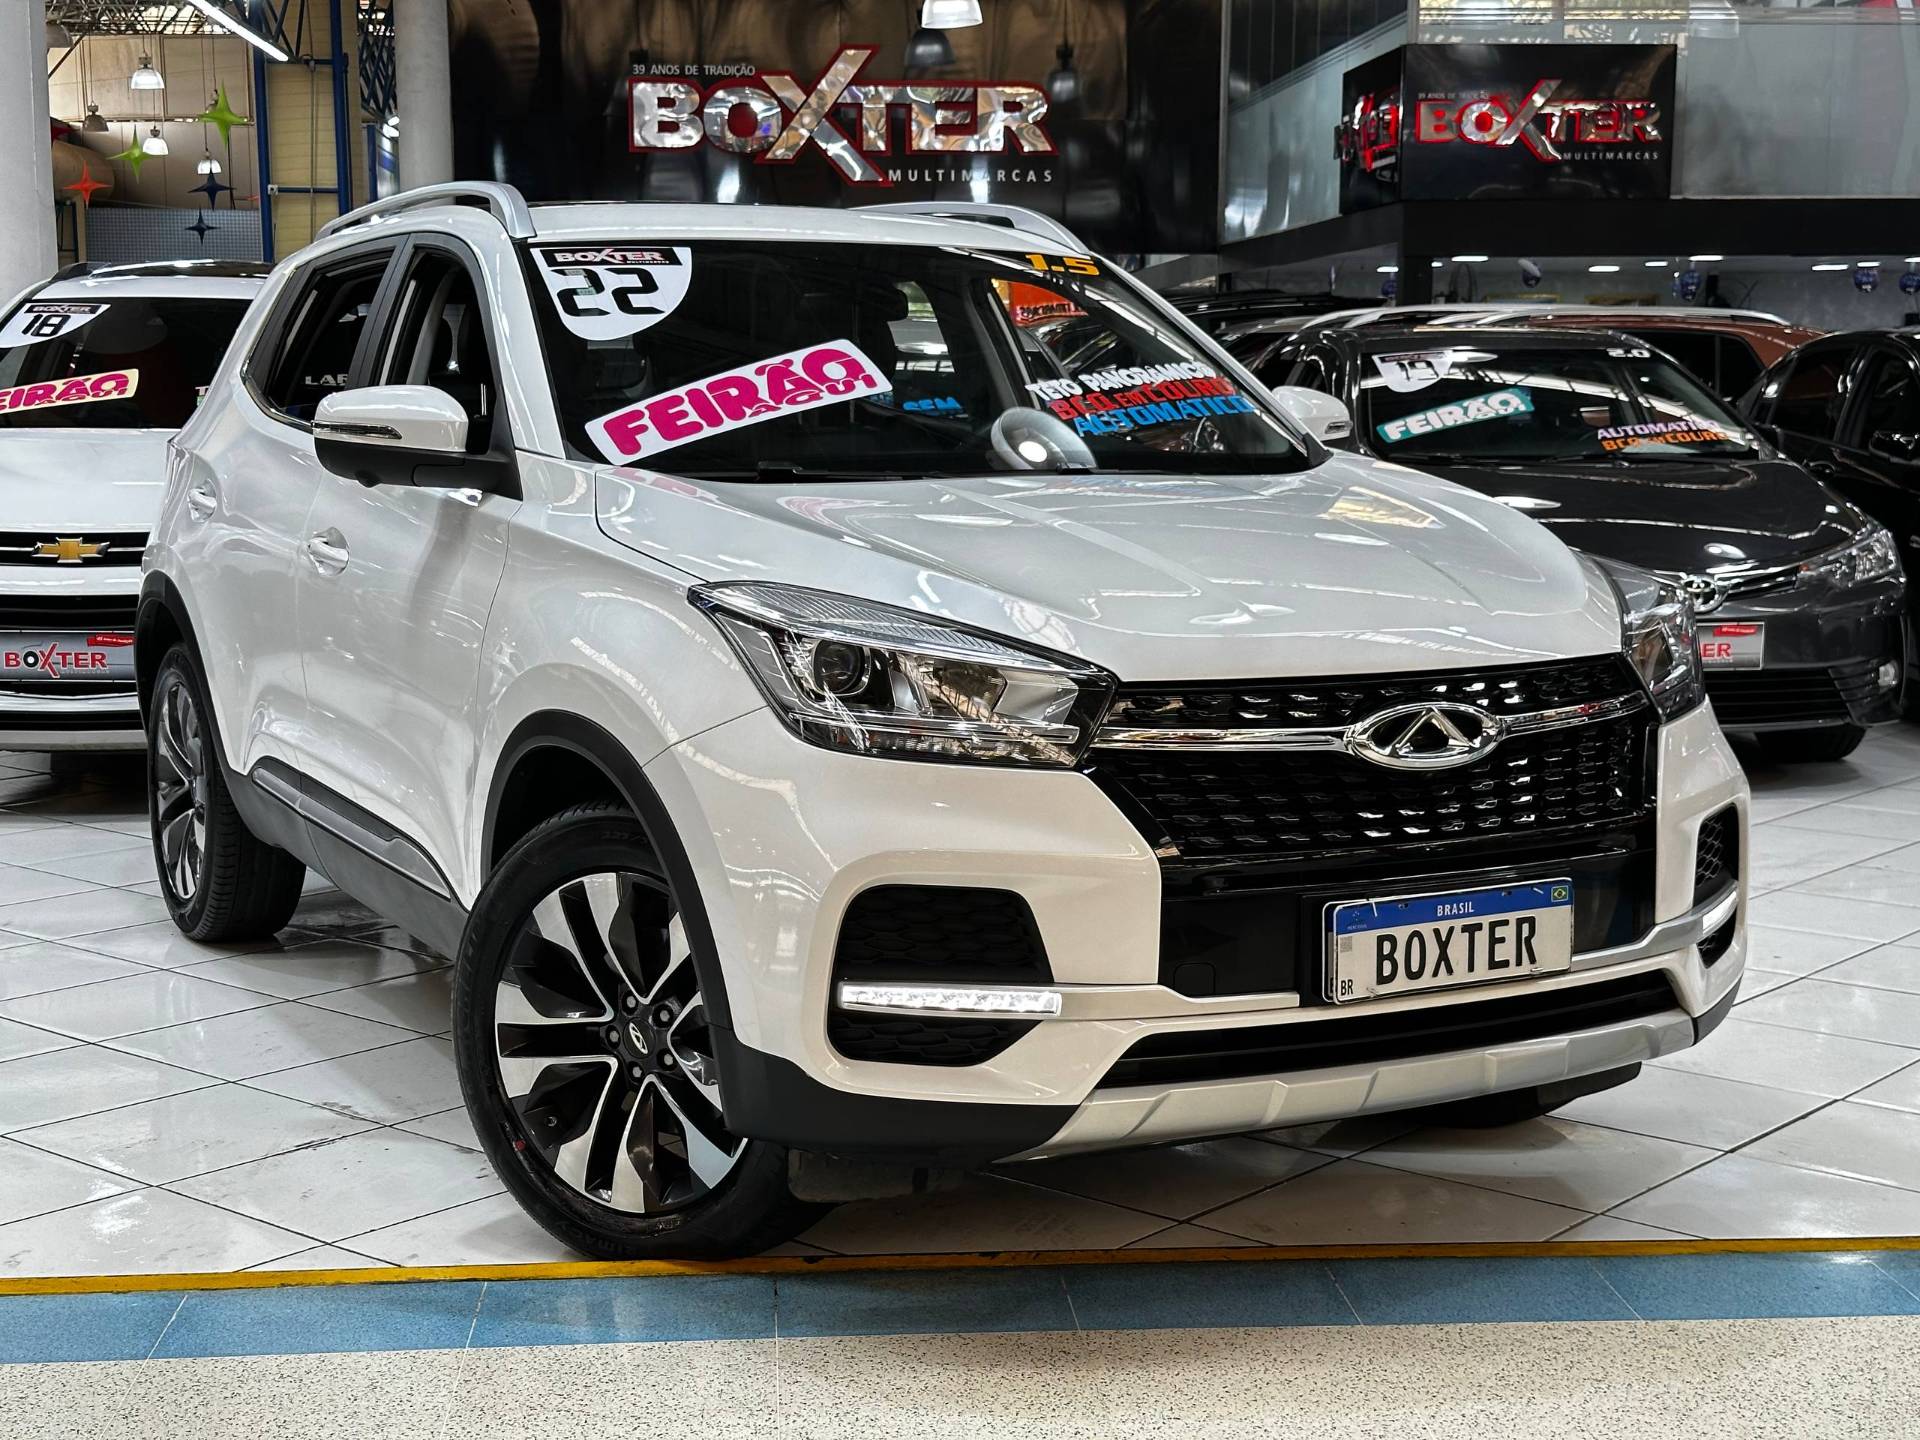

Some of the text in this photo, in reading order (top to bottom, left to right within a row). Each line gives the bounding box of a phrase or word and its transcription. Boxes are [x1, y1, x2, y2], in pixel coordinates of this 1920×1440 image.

[632, 62, 756, 78] 39 ANOS DE TRADIÇÃO
[629, 44, 1058, 187] BOXTER
[1415, 78, 1663, 164] BOXTER
[1562, 151, 1660, 161] MULTIMARCAS
[887, 168, 1053, 183] MULTIMARCAS
[553, 248, 665, 264] BOXTER
[1025, 253, 1100, 276] 1.5
[550, 267, 667, 317] 22
[32, 303, 92, 313] BOXTER
[21, 313, 72, 338] 18
[1606, 347, 1651, 359] 2.0
[1025, 377, 1083, 400] TETO
[1142, 375, 1240, 402] COURO
[602, 348, 867, 456] FEIRÃO
[1383, 391, 1523, 440] FEIRÃO
[3, 641, 109, 679] BOXTER
[1436, 901, 1475, 917] BRASIL
[1375, 915, 1537, 986] BOXTER
[1340, 978, 1354, 997] BR
